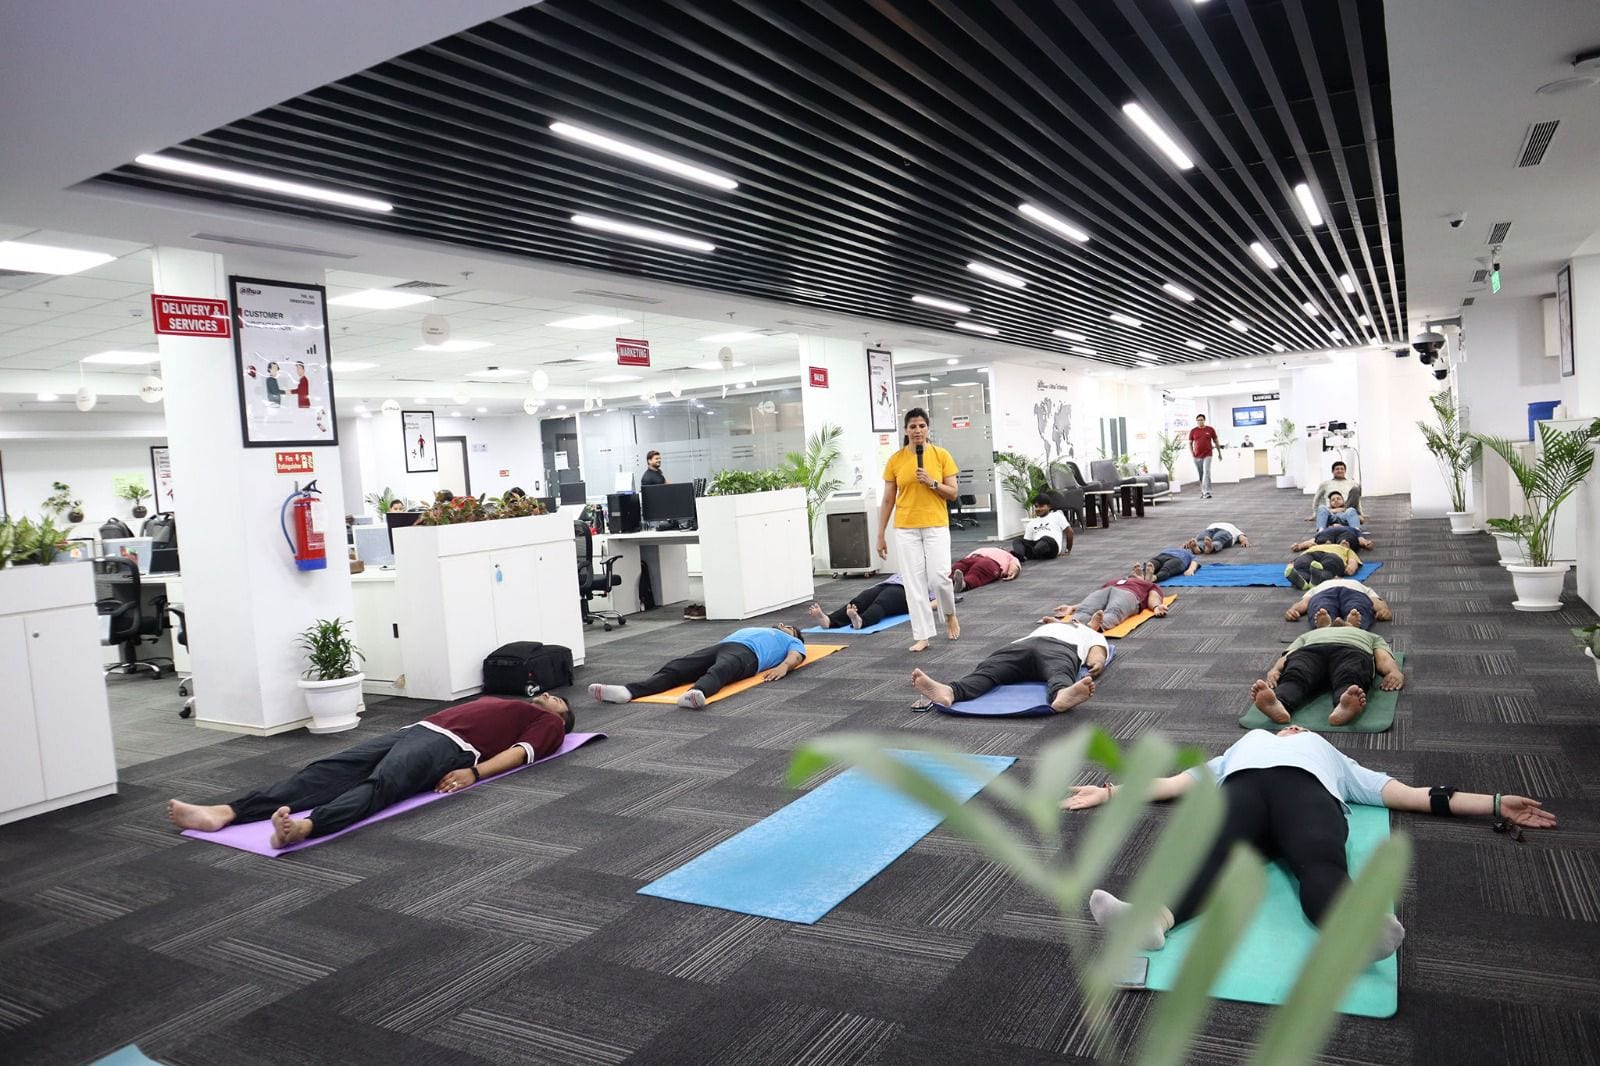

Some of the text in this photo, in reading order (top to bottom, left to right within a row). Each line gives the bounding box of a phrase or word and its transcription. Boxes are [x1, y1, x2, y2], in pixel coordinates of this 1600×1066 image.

[162, 302, 221, 316] DELIVERY &
[244, 309, 284, 319] CUSTOMER
[168, 317, 218, 332] SERVICES
[619, 347, 647, 358] MARKETING
